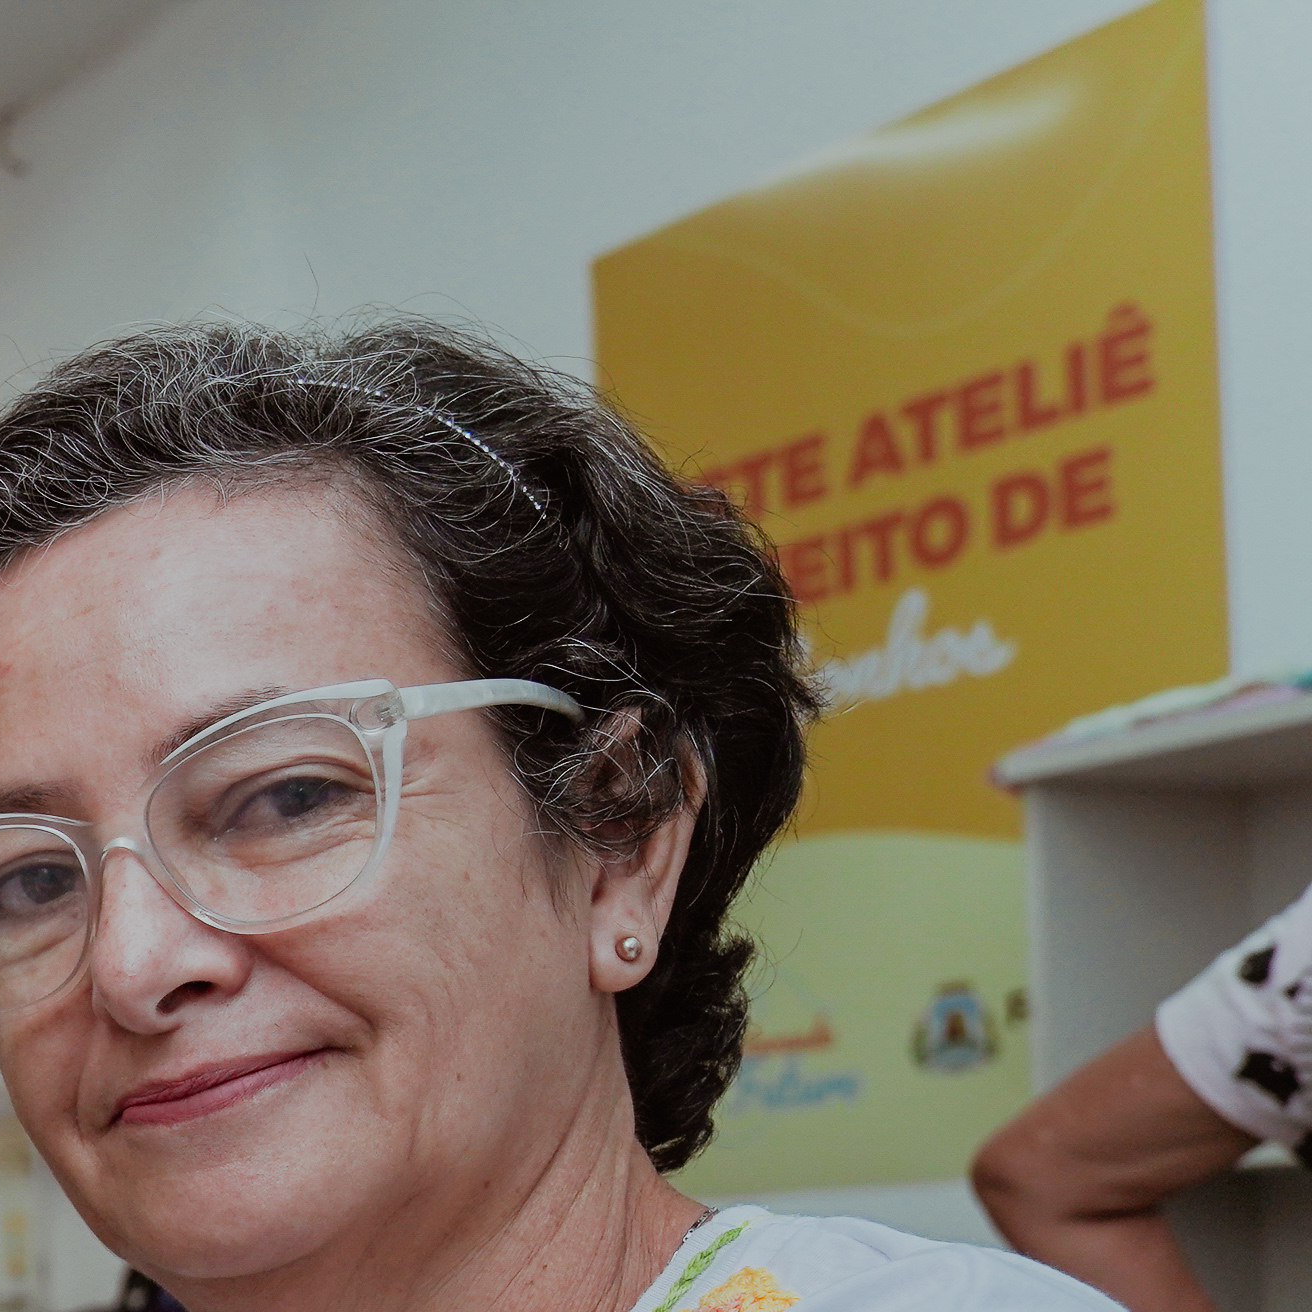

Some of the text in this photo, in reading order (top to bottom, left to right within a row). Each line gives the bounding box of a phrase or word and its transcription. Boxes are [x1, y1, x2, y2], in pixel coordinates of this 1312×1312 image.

[848, 301, 1156, 489] ATELIÊ
[768, 445, 1116, 606] EITO DE
